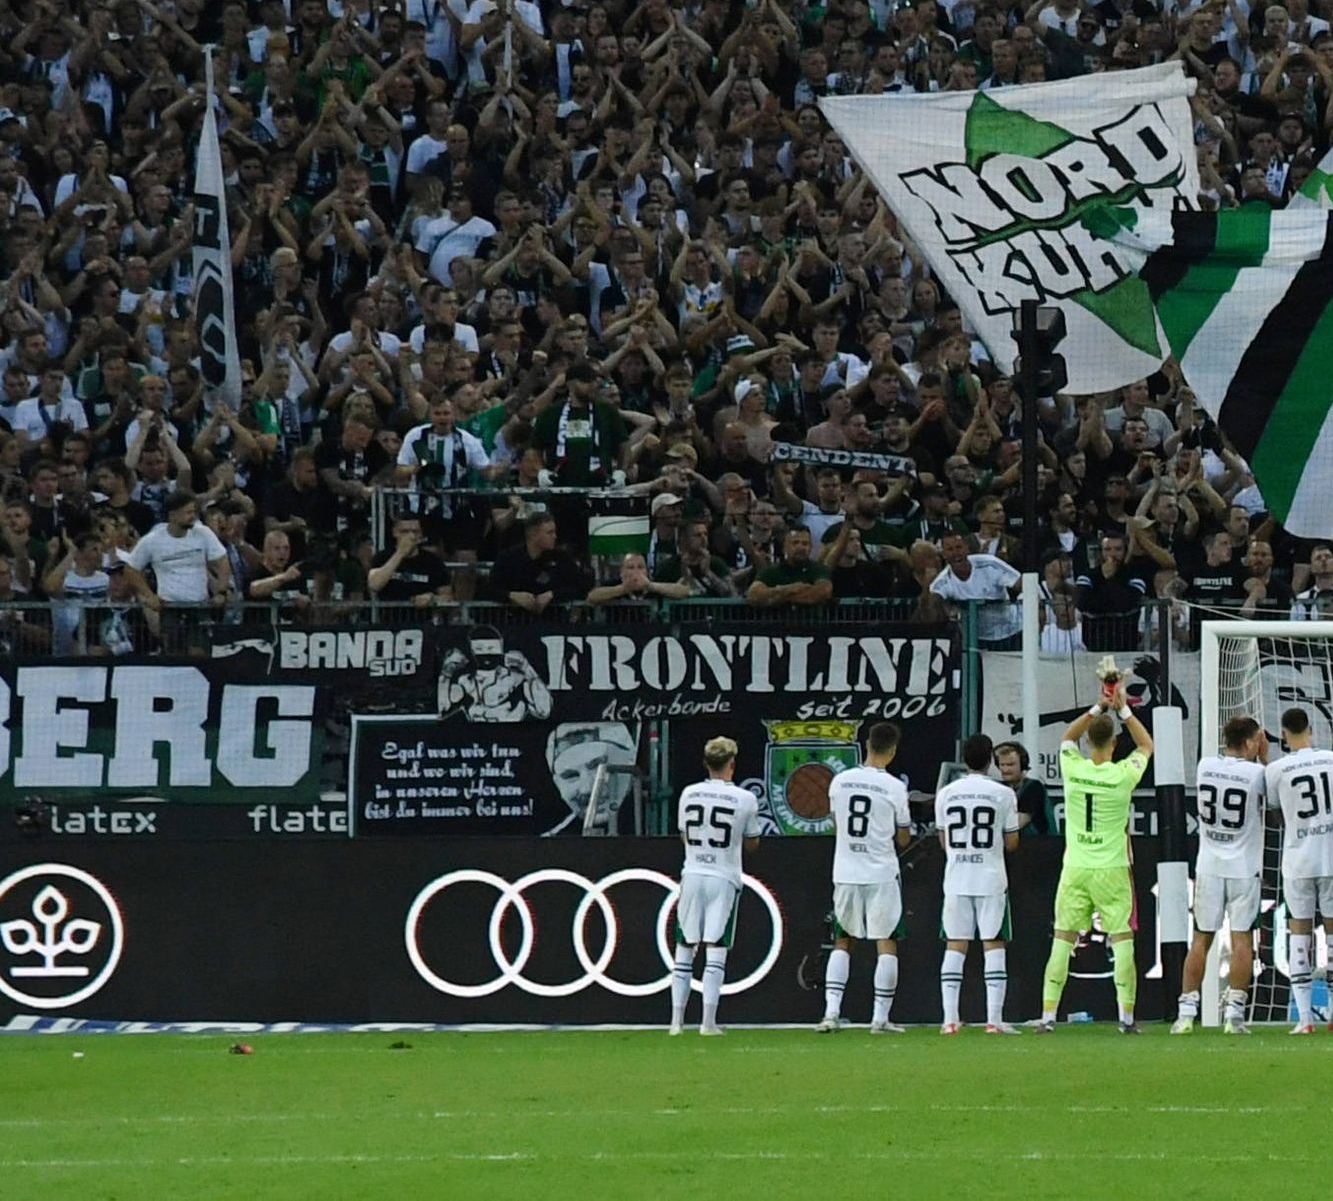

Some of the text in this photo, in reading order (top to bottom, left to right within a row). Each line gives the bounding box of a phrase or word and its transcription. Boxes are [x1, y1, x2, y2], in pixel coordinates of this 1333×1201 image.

[899, 102, 1185, 245] NORD
[280, 628, 424, 669] BANDA
[540, 634, 952, 696] FRONTLINE
[0, 664, 315, 788] ERG
[601, 693, 948, 723] Ackerbande seit 2006
[847, 794, 872, 838] 8
[1084, 792, 1094, 833] 1
[1198, 783, 1248, 830] 39
[1290, 771, 1332, 820] 31
[51, 805, 157, 834] latex
[248, 805, 348, 833] flate
[684, 804, 736, 849] 25
[946, 805, 996, 849] 28
